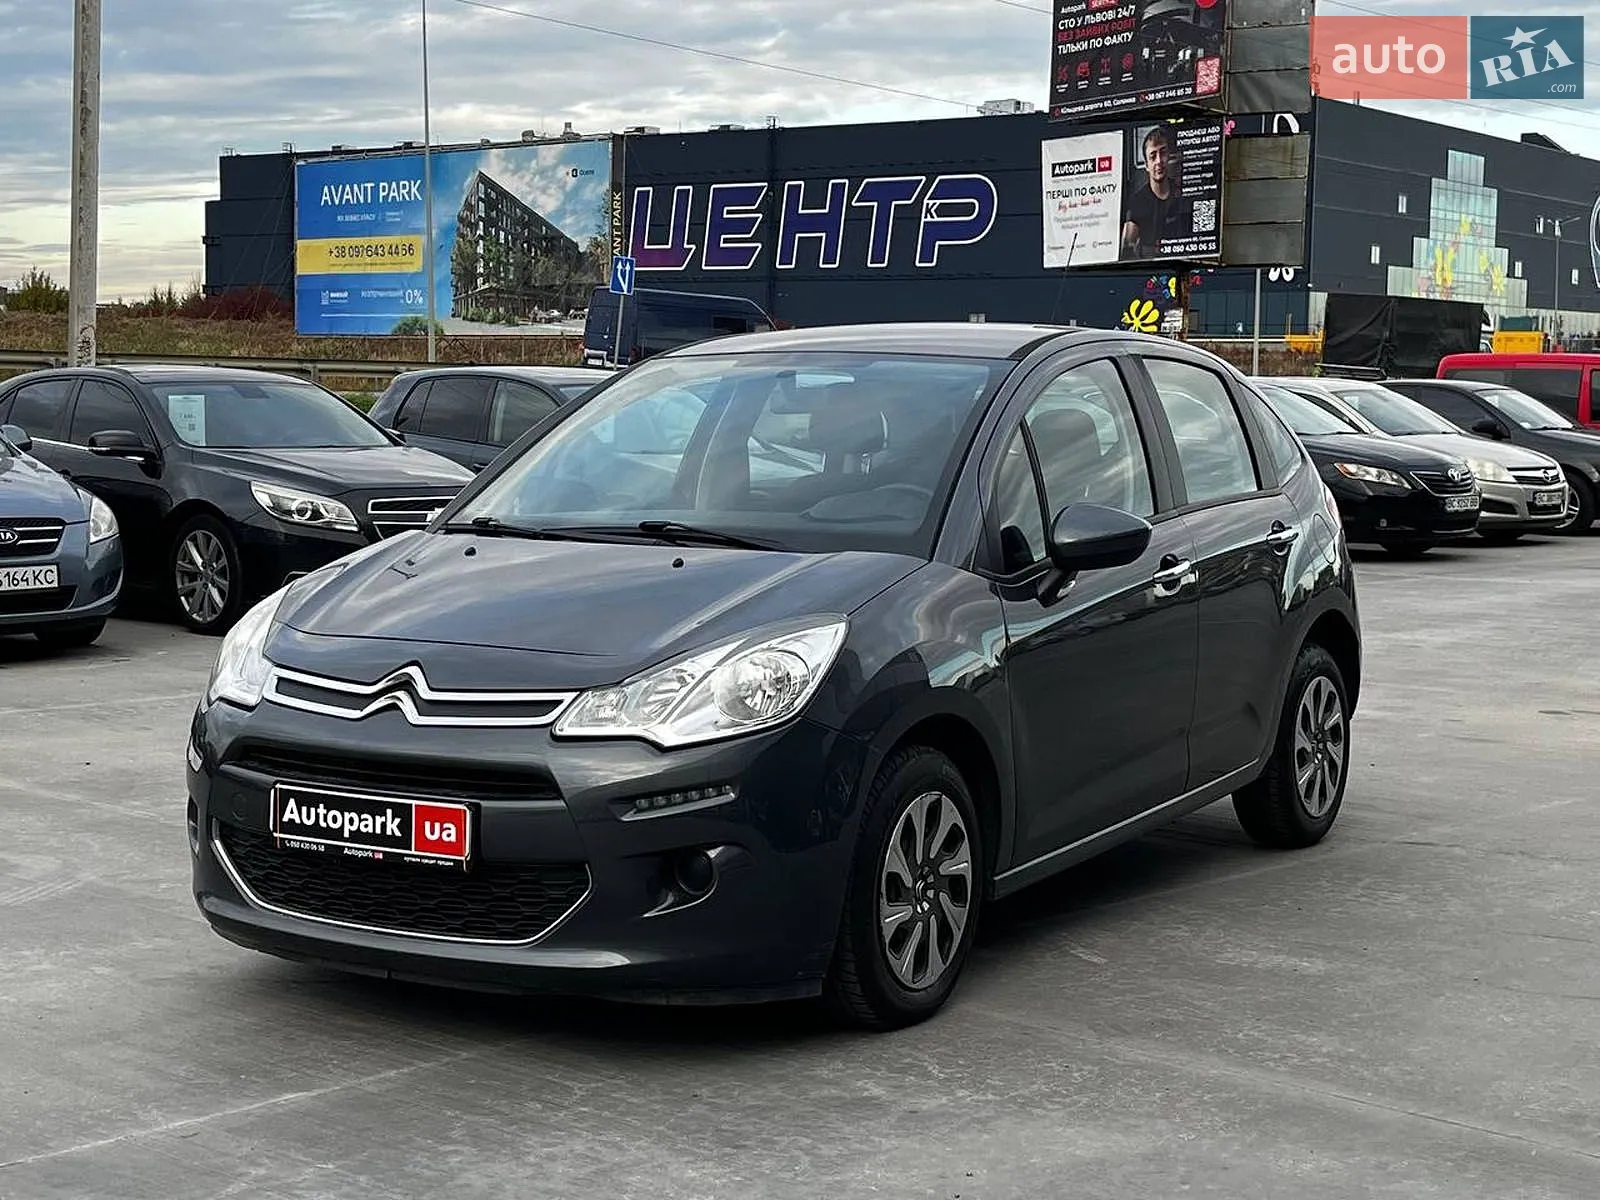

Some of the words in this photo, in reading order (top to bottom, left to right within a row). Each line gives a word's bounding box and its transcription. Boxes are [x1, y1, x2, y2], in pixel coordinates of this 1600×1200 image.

[1058, 18, 1076, 30] СТО
[1077, 15, 1083, 27] У
[1084, 10, 1116, 25] ЛЬВОВІ
[1117, 4, 1136, 18] 24/7
[1057, 41, 1088, 55] ТІЛЬКИ
[1090, 38, 1103, 49] ПО
[1104, 31, 1133, 46] ФАКТУ
[1054, 160, 1093, 175] Autopark
[321, 183, 375, 206] AVANT
[379, 180, 423, 203] PARK
[1046, 188, 1073, 200] ПЕРШІ
[1075, 187, 1087, 198] ПО
[1089, 183, 1117, 195] ФАКТУ
[612, 191, 621, 226] PARK
[628, 173, 998, 271] ЦЕНТР
[329, 246, 346, 258] +38
[612, 229, 621, 256] ANT
[405, 289, 423, 304] 0%
[282, 798, 402, 838] Autopark
[424, 820, 457, 842] ua
[343, 847, 374, 858] Autopark
